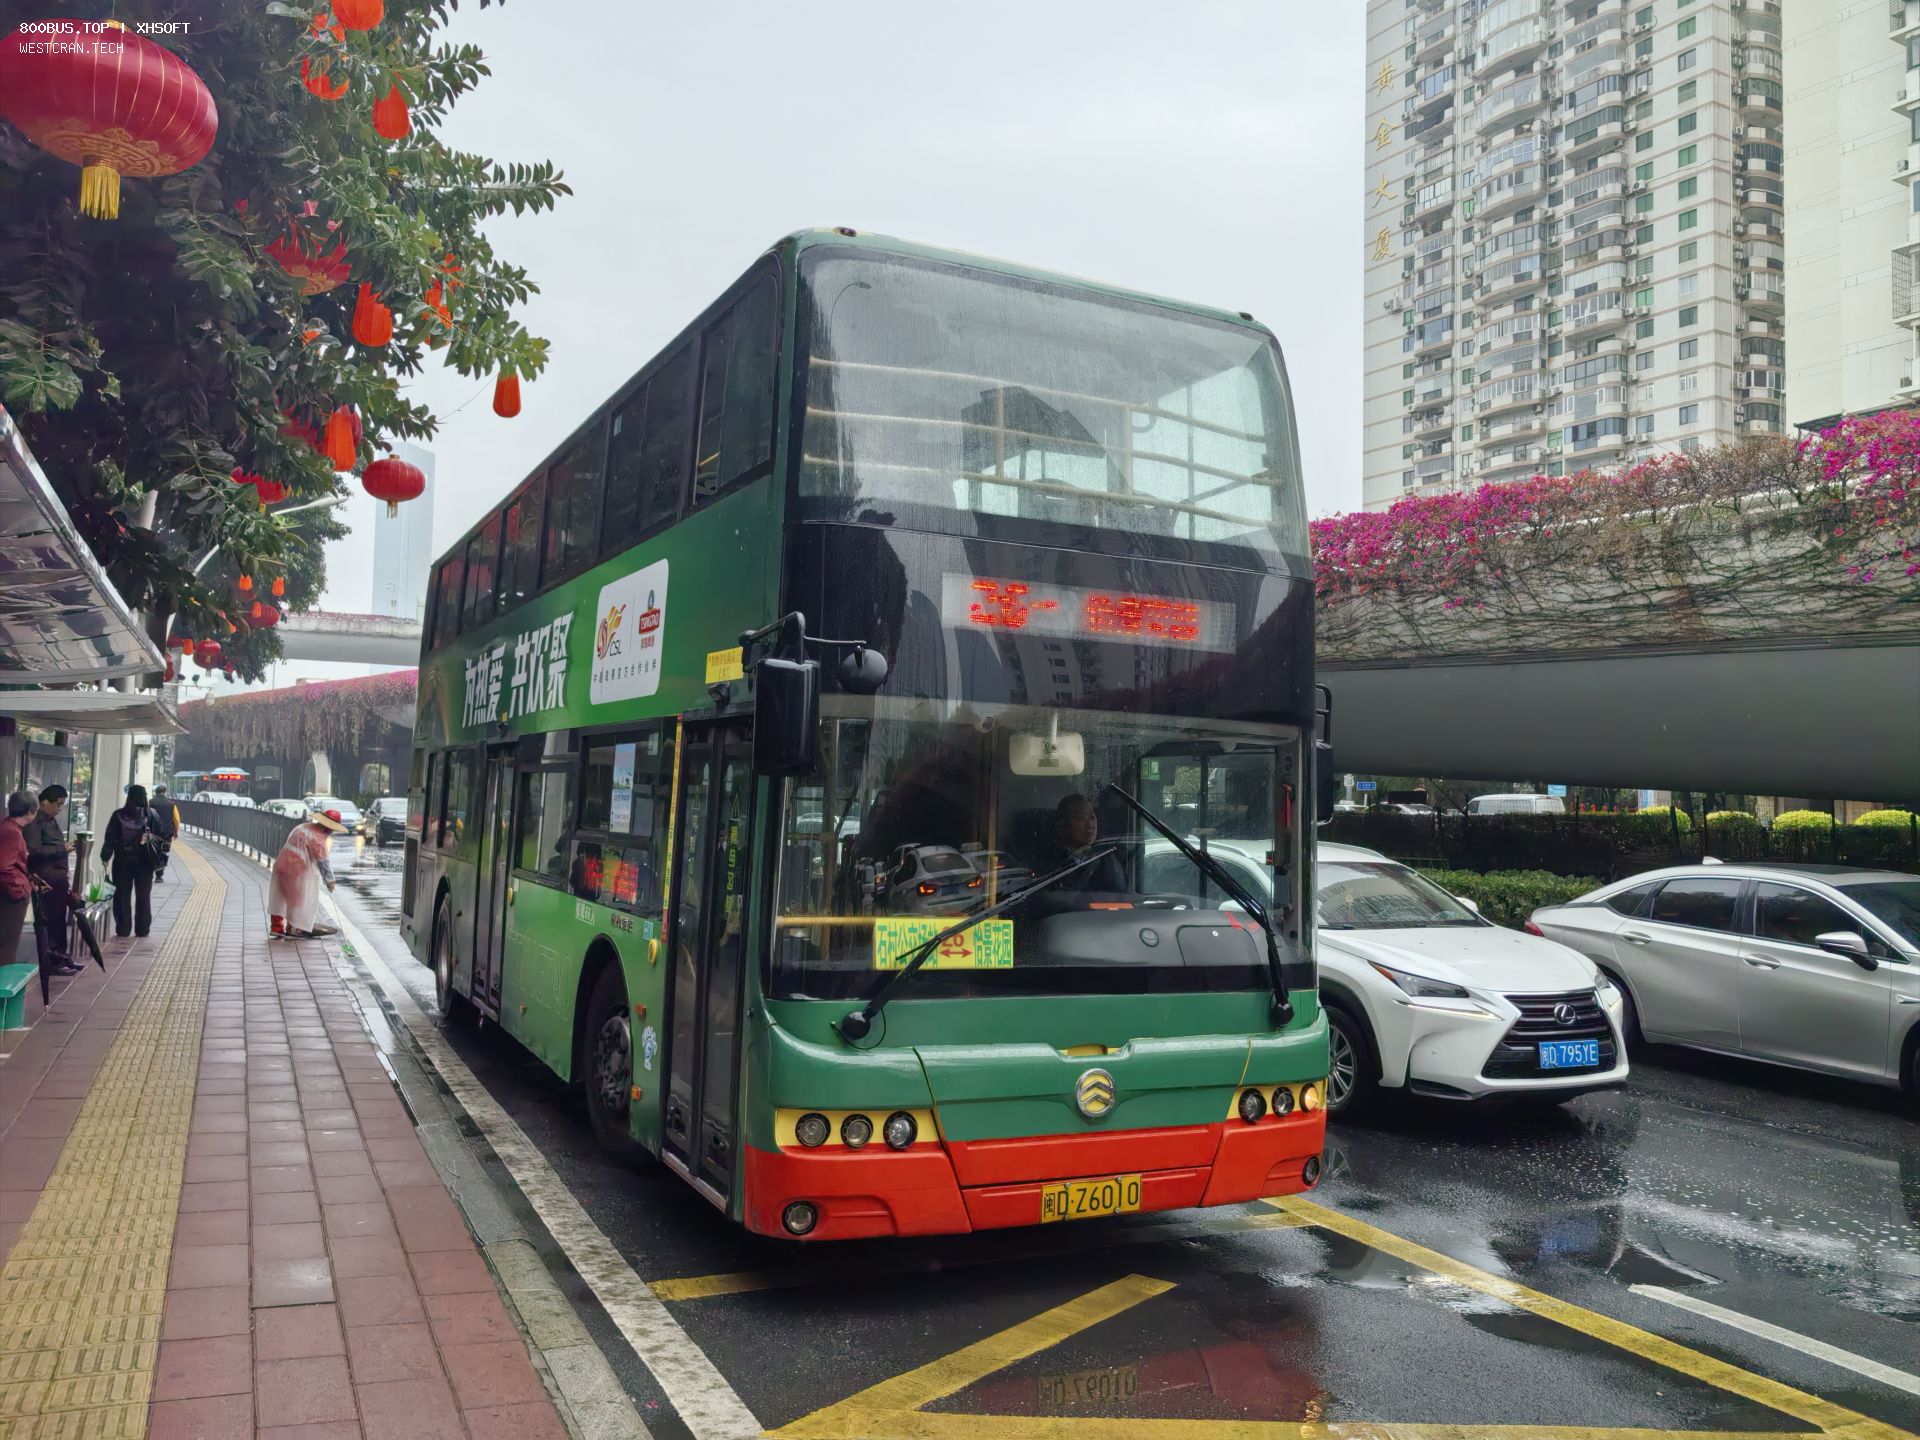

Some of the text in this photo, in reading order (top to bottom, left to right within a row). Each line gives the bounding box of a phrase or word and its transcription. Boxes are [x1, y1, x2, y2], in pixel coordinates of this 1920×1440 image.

[1371, 58, 1399, 262] 黄金大厦
[973, 921, 1011, 968] 怡景花园
